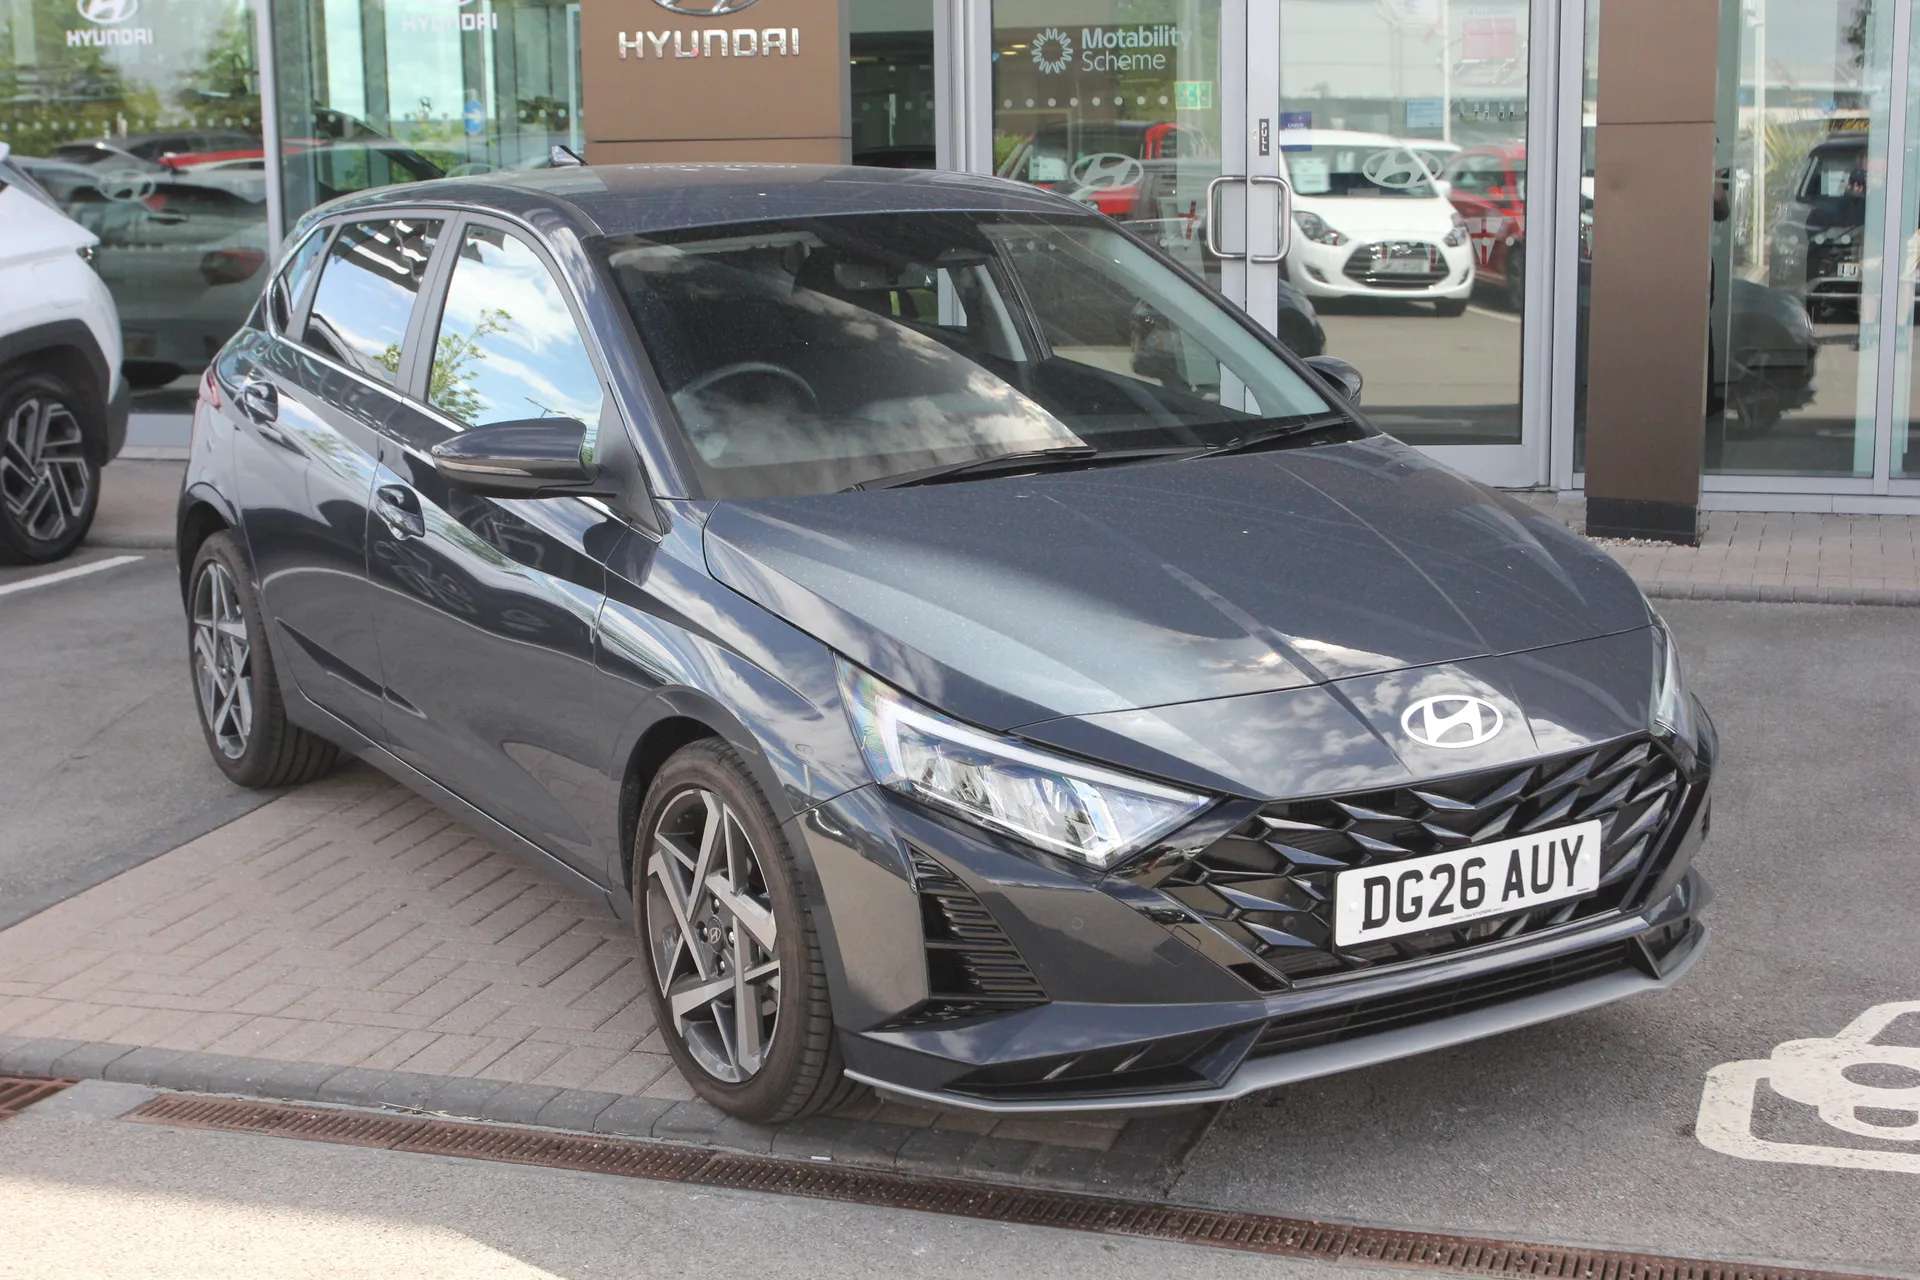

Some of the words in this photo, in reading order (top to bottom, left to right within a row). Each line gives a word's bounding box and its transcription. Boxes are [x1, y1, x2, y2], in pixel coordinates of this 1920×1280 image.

[66, 28, 153, 47] HYUNDAI
[618, 27, 800, 59] HYUNDAI
[1081, 25, 1193, 52] Motability
[1081, 51, 1167, 72] Scheme
[1260, 121, 1268, 152] PULL
[1362, 856, 1486, 931] DG26
[1501, 834, 1585, 902] AUY
